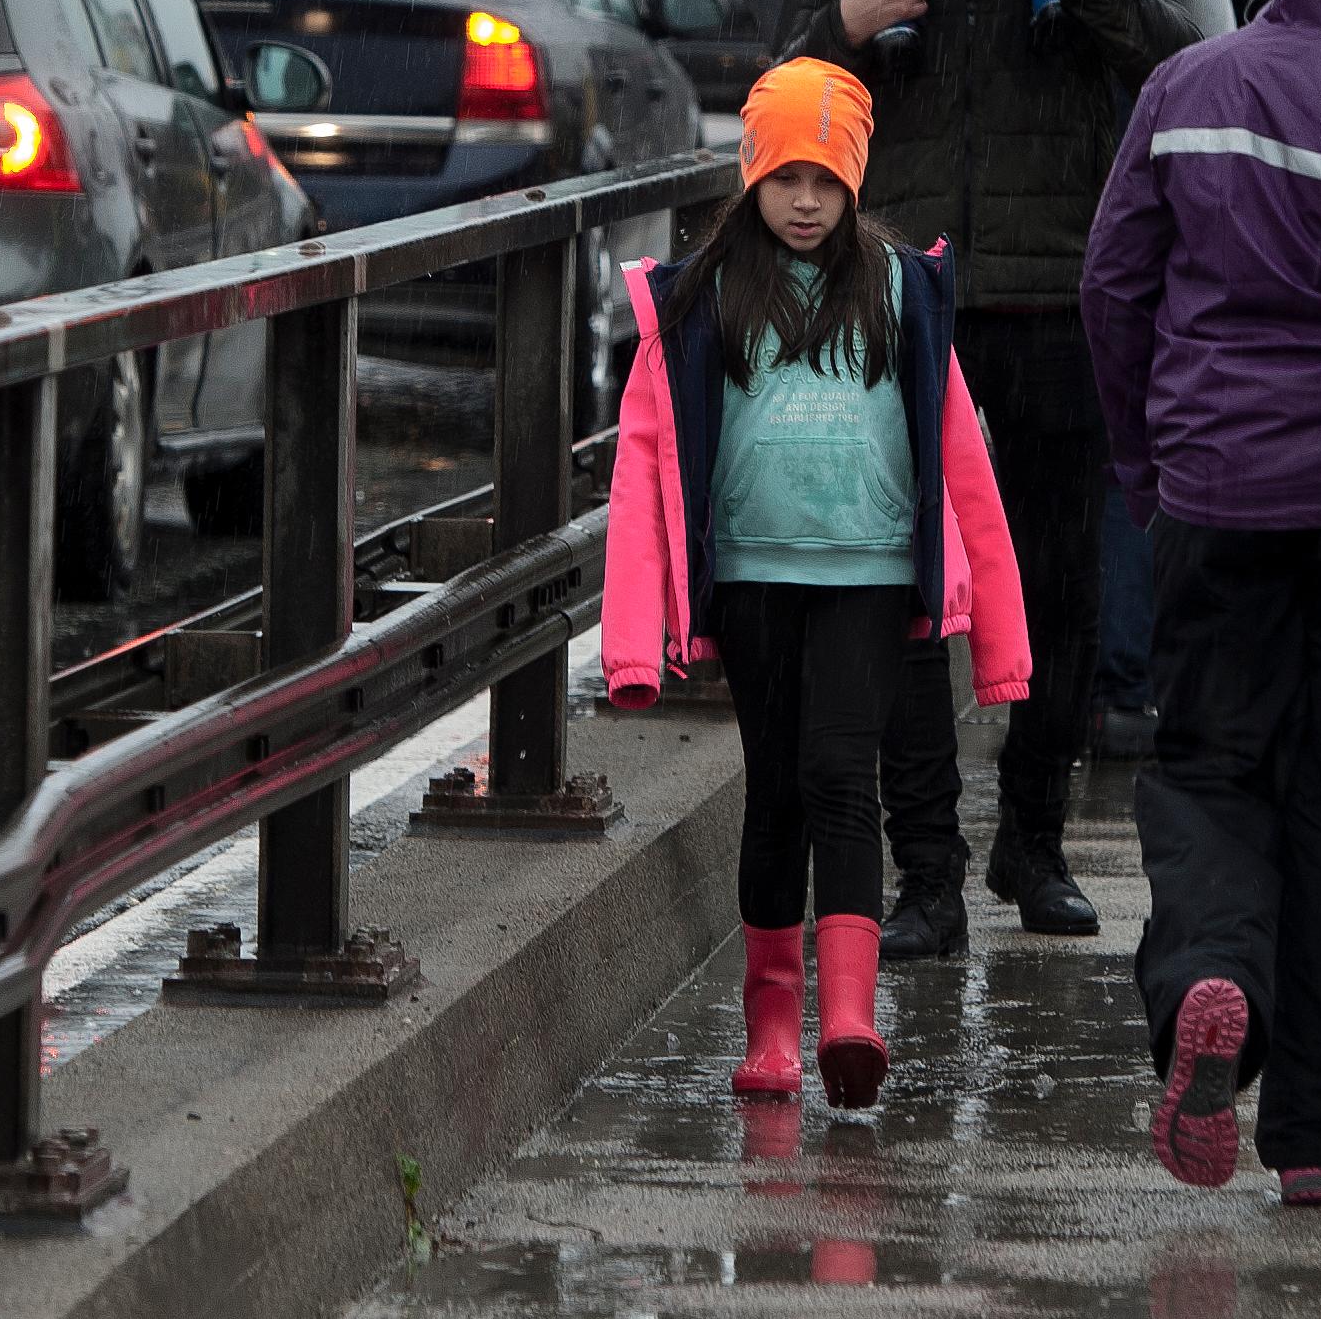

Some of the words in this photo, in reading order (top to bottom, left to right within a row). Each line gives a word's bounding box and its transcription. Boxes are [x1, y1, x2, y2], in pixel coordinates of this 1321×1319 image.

[820, 391, 861, 402] QUALITY
[785, 402, 807, 412] AND
[809, 401, 847, 412] DESIGN
[769, 413, 836, 425] ESTABLISHED
